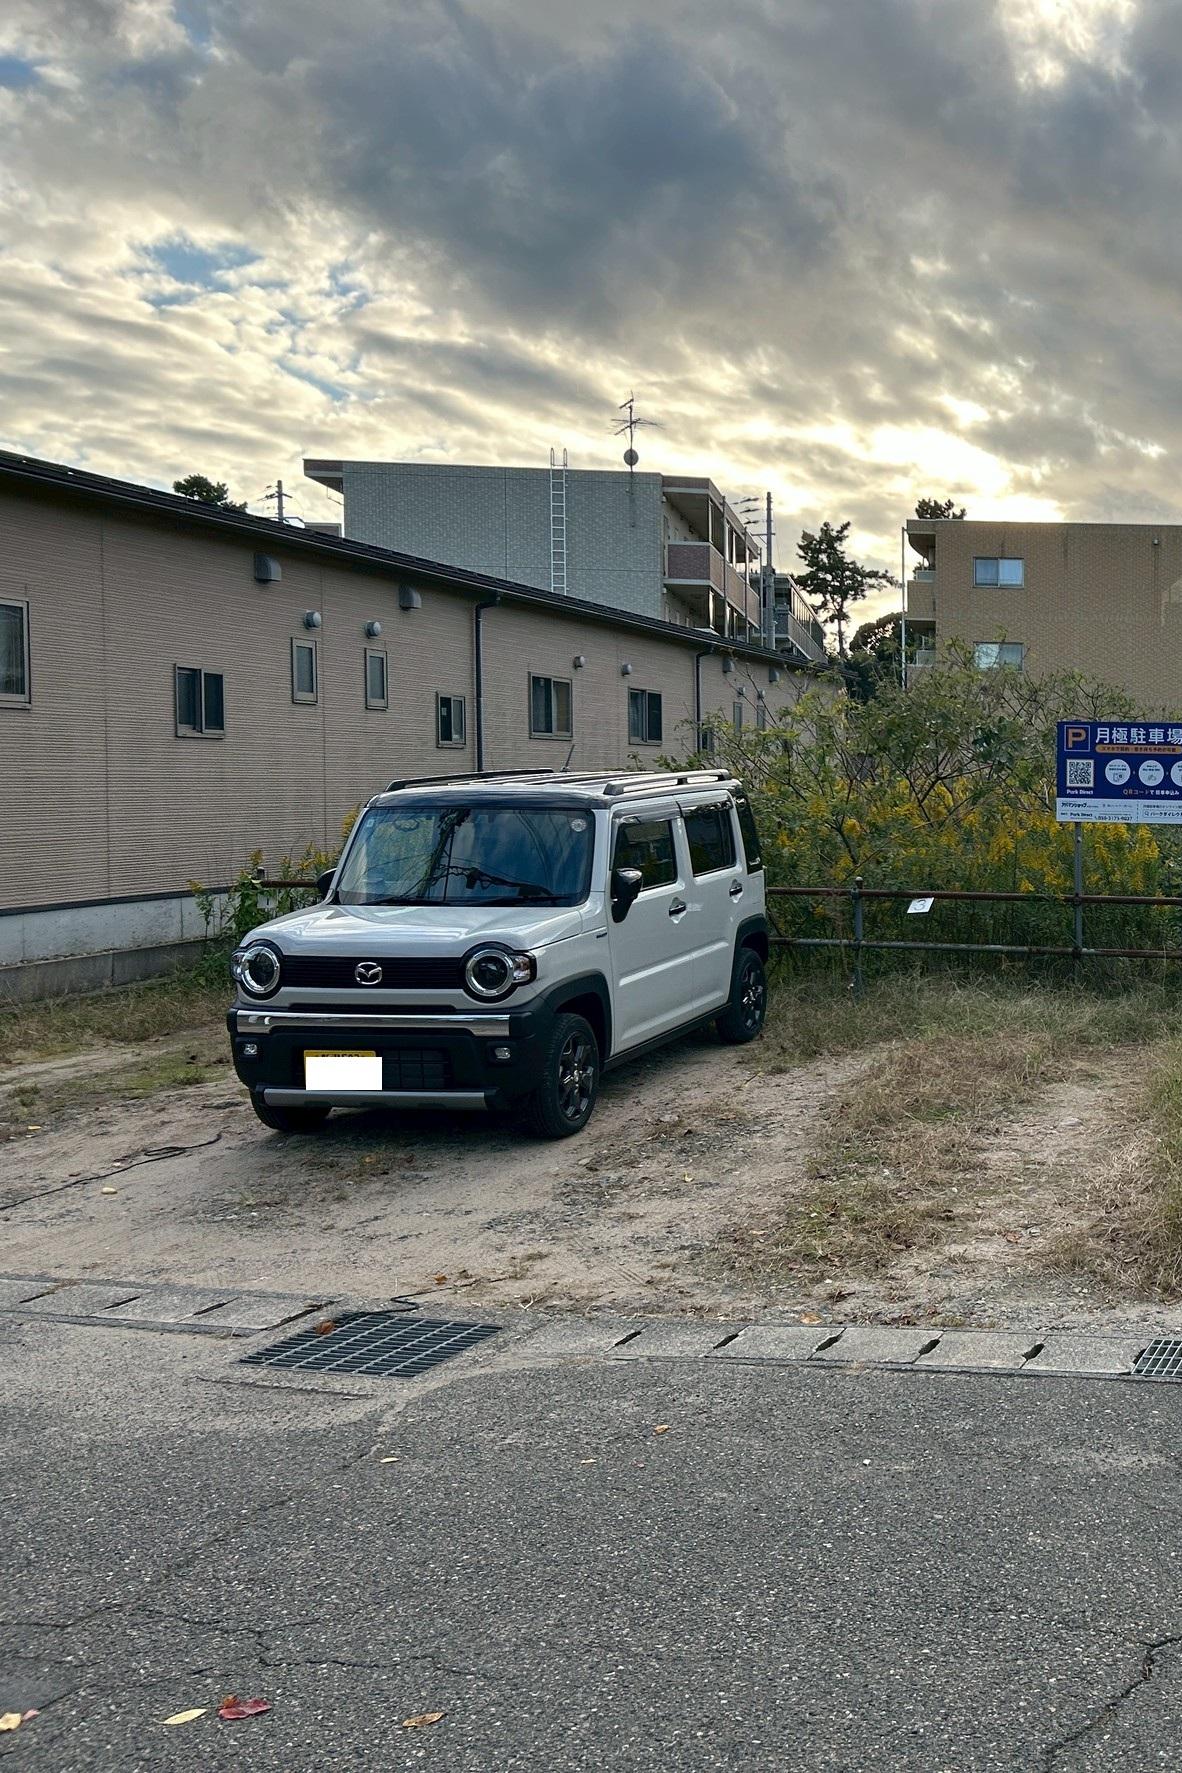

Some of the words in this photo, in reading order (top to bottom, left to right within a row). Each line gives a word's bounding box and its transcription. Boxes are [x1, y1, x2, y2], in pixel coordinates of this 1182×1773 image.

[1067, 728, 1087, 748] P
[1095, 727, 1182, 745] 月極駐車場
[914, 899, 927, 911] 3
